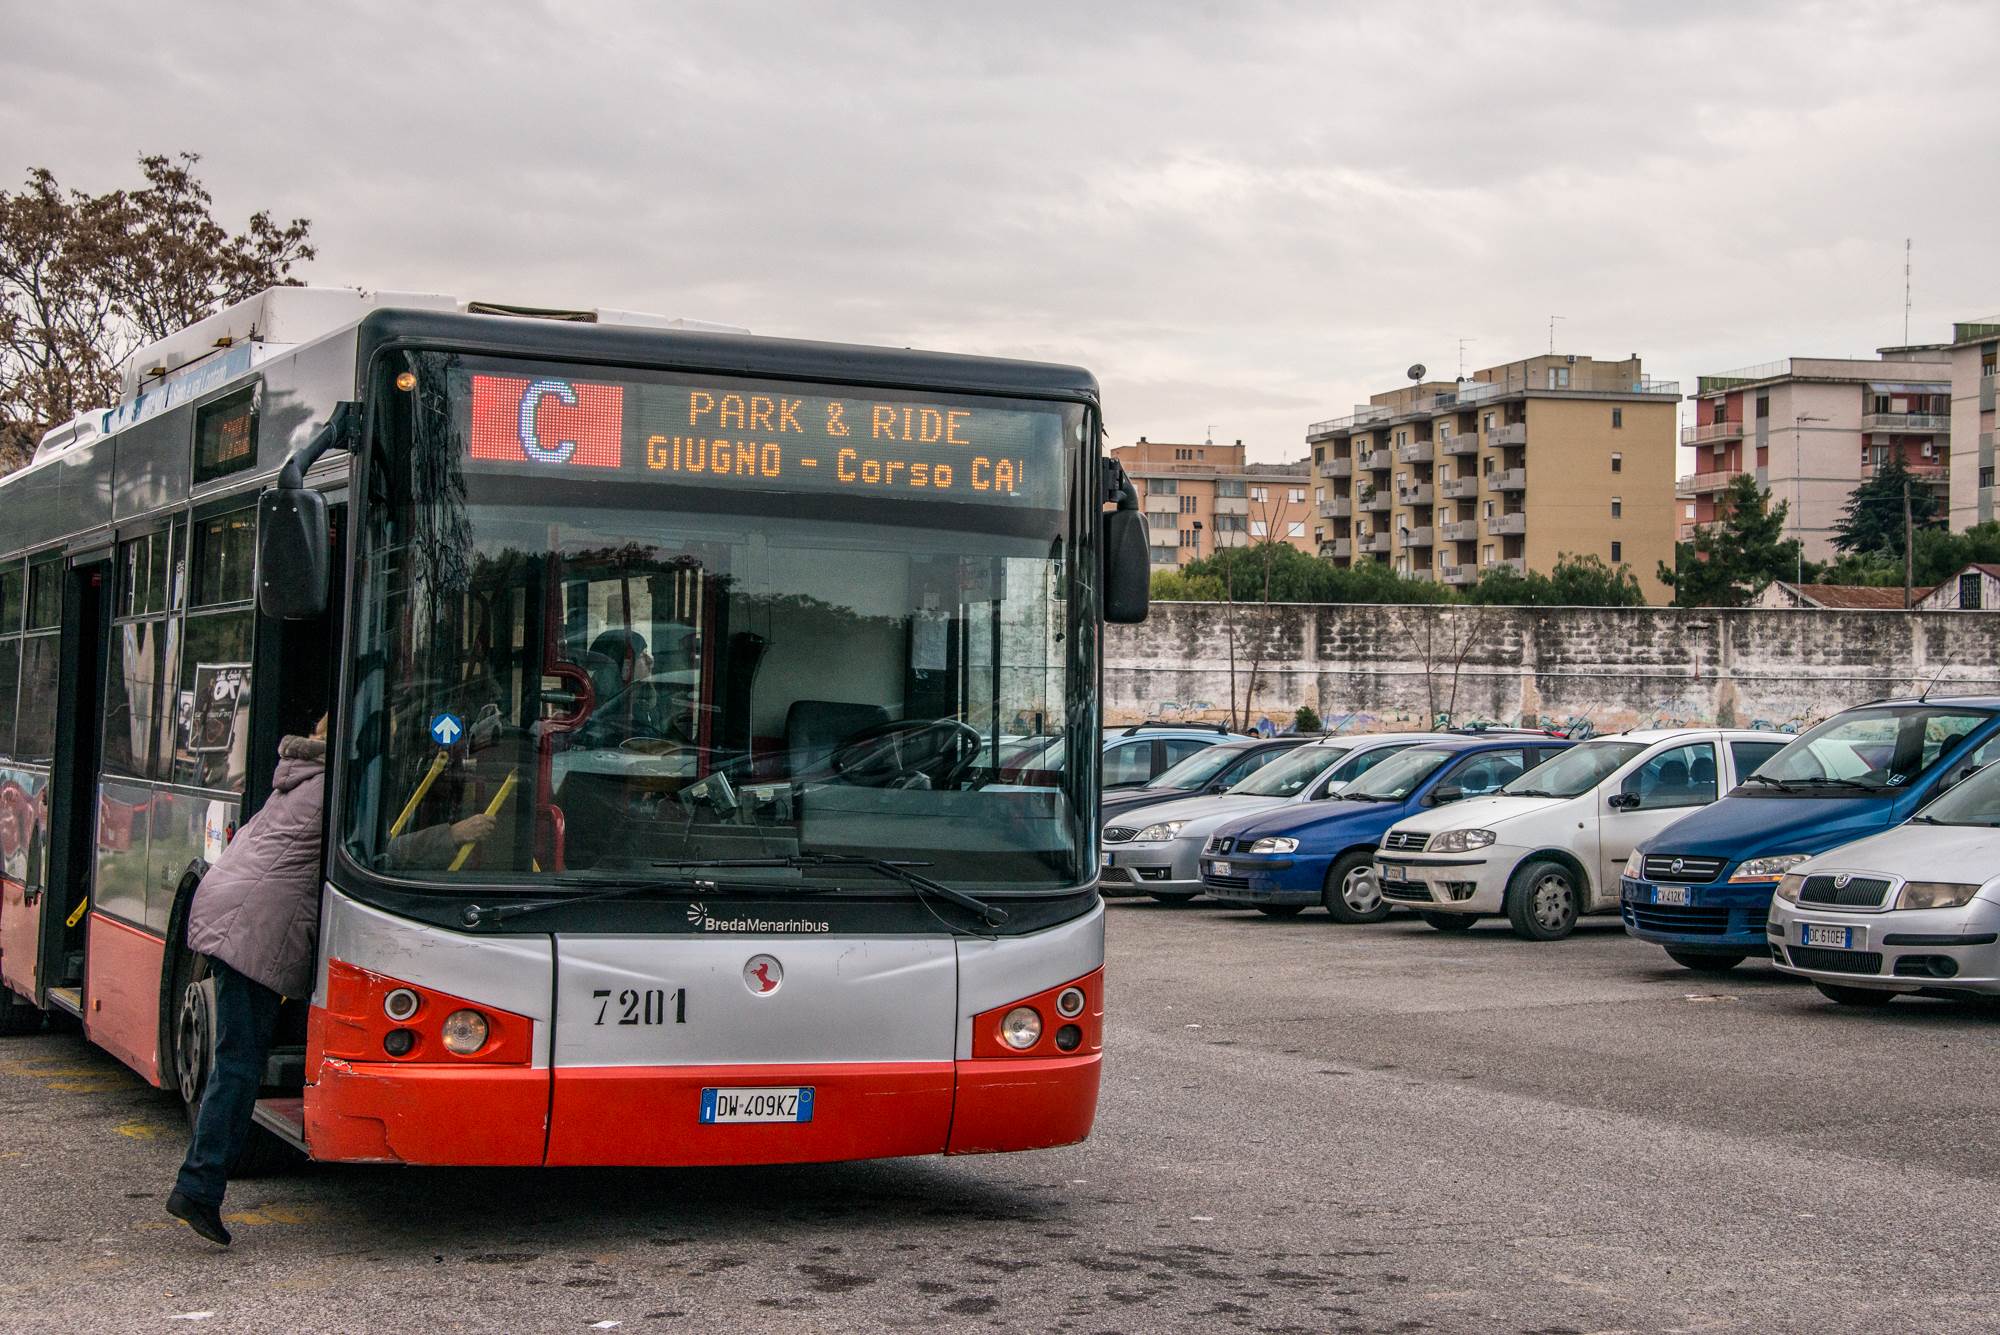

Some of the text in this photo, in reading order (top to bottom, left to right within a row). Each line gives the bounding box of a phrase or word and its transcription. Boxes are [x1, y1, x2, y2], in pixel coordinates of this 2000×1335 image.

[520, 380, 577, 463] C
[689, 391, 972, 445] PARK & RIDE
[647, 434, 782, 477] GIUGNO
[837, 447, 953, 488] Corso
[971, 456, 1024, 492] CA
[704, 917, 830, 932] BredaMenarinibus
[592, 988, 687, 1026] 7201
